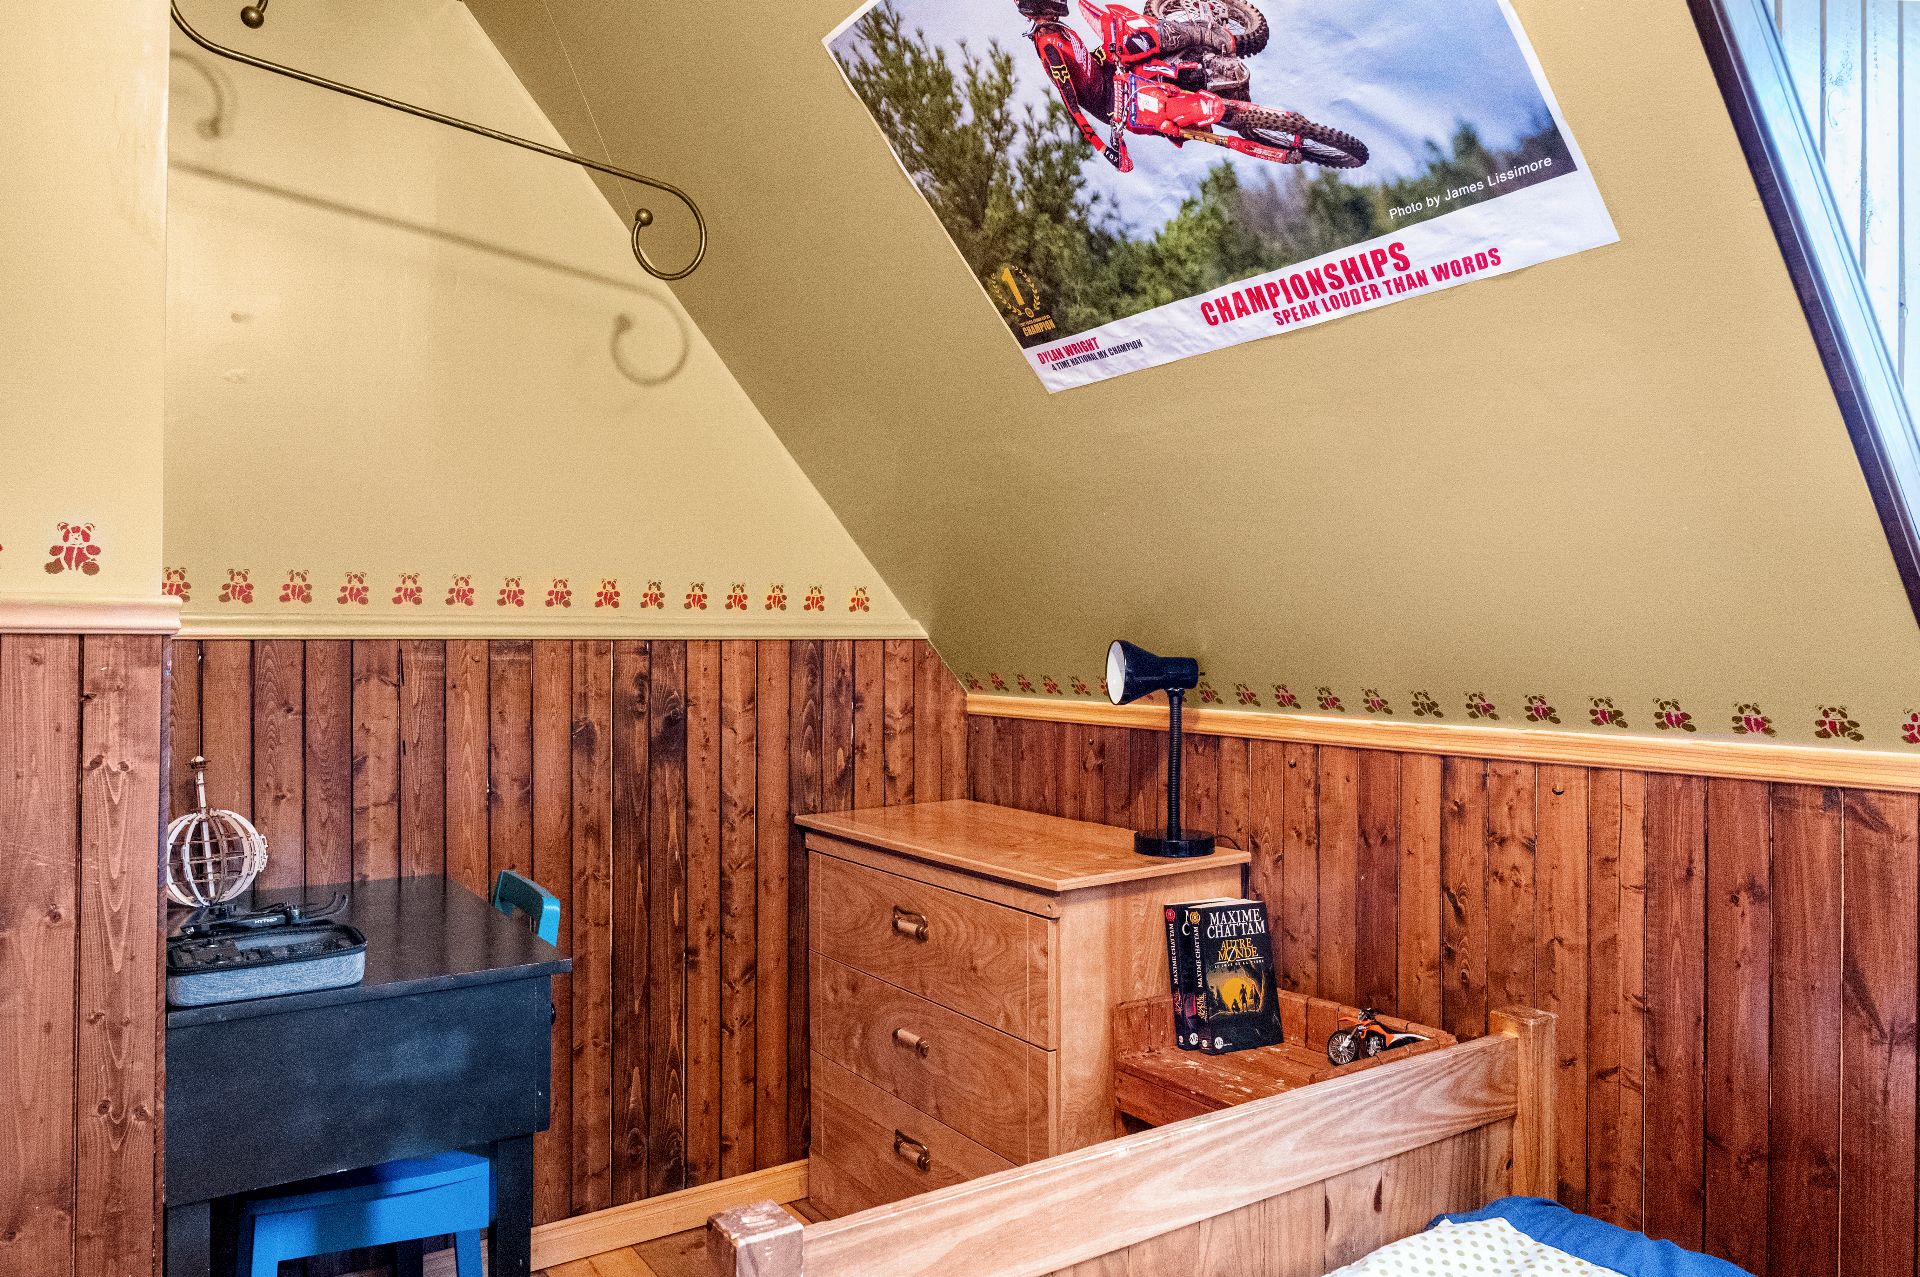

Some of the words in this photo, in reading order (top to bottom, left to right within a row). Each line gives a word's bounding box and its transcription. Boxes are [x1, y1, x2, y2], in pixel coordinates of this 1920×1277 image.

[1105, 150, 1119, 162] FOX
[1388, 202, 1423, 219] Photo
[1425, 196, 1441, 208] by
[1444, 180, 1484, 201] James
[1487, 156, 1552, 188] Lissimore
[1200, 242, 1412, 327] CHAMPIONSHIPS
[1272, 299, 1320, 327] SPEAK
[1319, 284, 1381, 312] LOUDER
[1382, 268, 1429, 297] THAN
[1431, 247, 1502, 281] WORDS
[1022, 319, 1056, 337] CHAMPION
[1037, 348, 1065, 364] DYLAN
[1062, 337, 1100, 358] WRIGHT
[1051, 363, 1058, 371] 4
[1057, 359, 1072, 370] TIME
[1070, 352, 1100, 367] NATIONAL
[1098, 349, 1109, 360] MX
[1108, 339, 1143, 356] CHAMPION
[1207, 920, 1266, 939] CHATTAM
[1209, 908, 1262, 926] MAXIME
[1169, 923, 1177, 956] CHATTAM
[1194, 926, 1202, 960] CHATTAM
[1221, 937, 1254, 950] AUTRE
[1171, 956, 1179, 985] MAXIME
[1196, 960, 1204, 988] MAXIME
